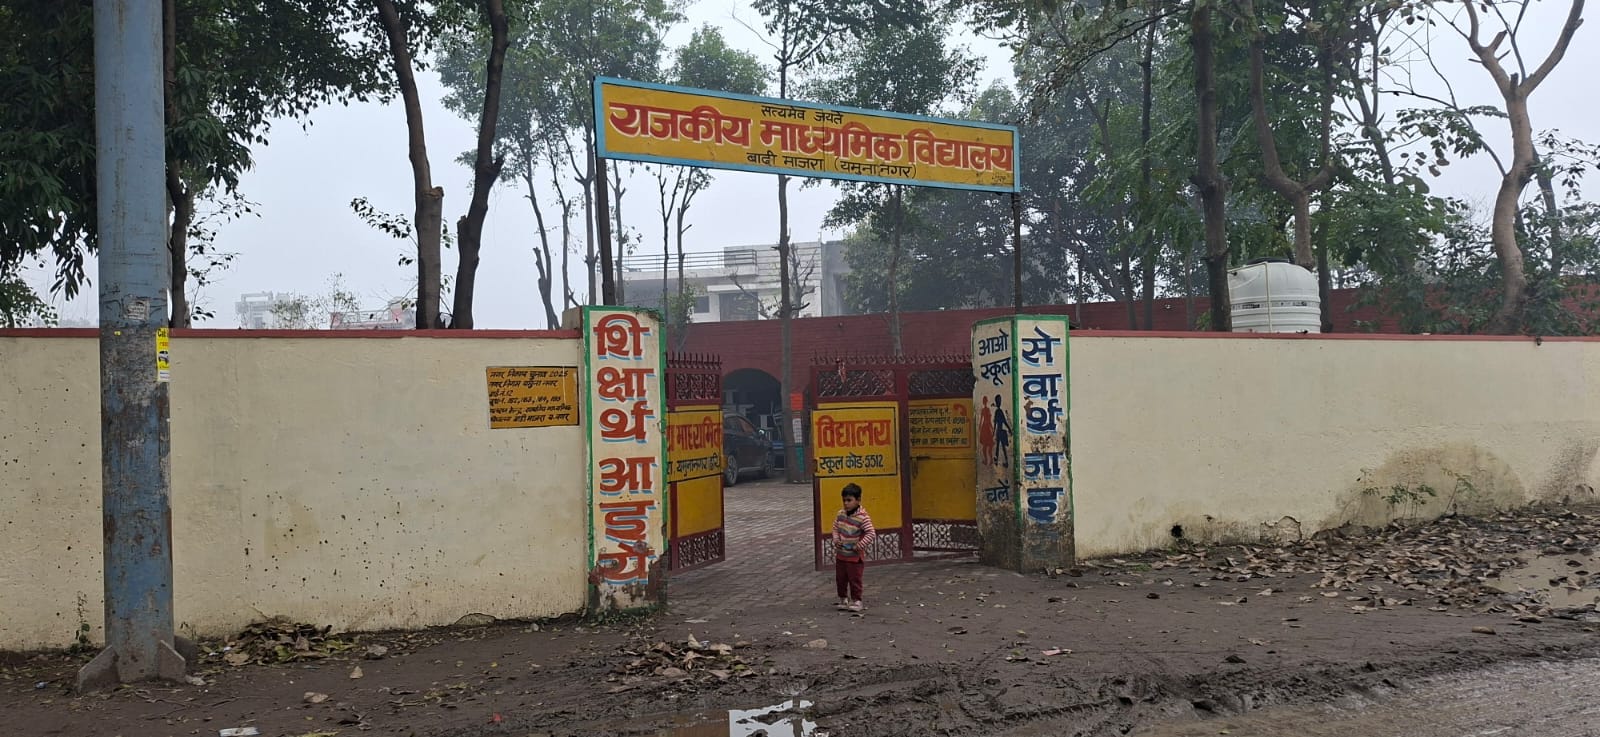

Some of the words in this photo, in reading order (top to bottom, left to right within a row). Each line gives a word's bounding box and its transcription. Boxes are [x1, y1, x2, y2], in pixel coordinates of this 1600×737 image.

[761, 105, 806, 121] सत्यमेव
[813, 110, 843, 125] जयते
[608, 102, 752, 150] राजकीय
[759, 120, 904, 165] माध्यमिक
[906, 128, 1014, 174] विद्यालय
[782, 154, 825, 171] माजरा
[978, 328, 1009, 357] आओ
[980, 356, 1012, 386] स्कूल
[816, 415, 891, 448] विद्यालय
[819, 456, 844, 474] स्कूल
